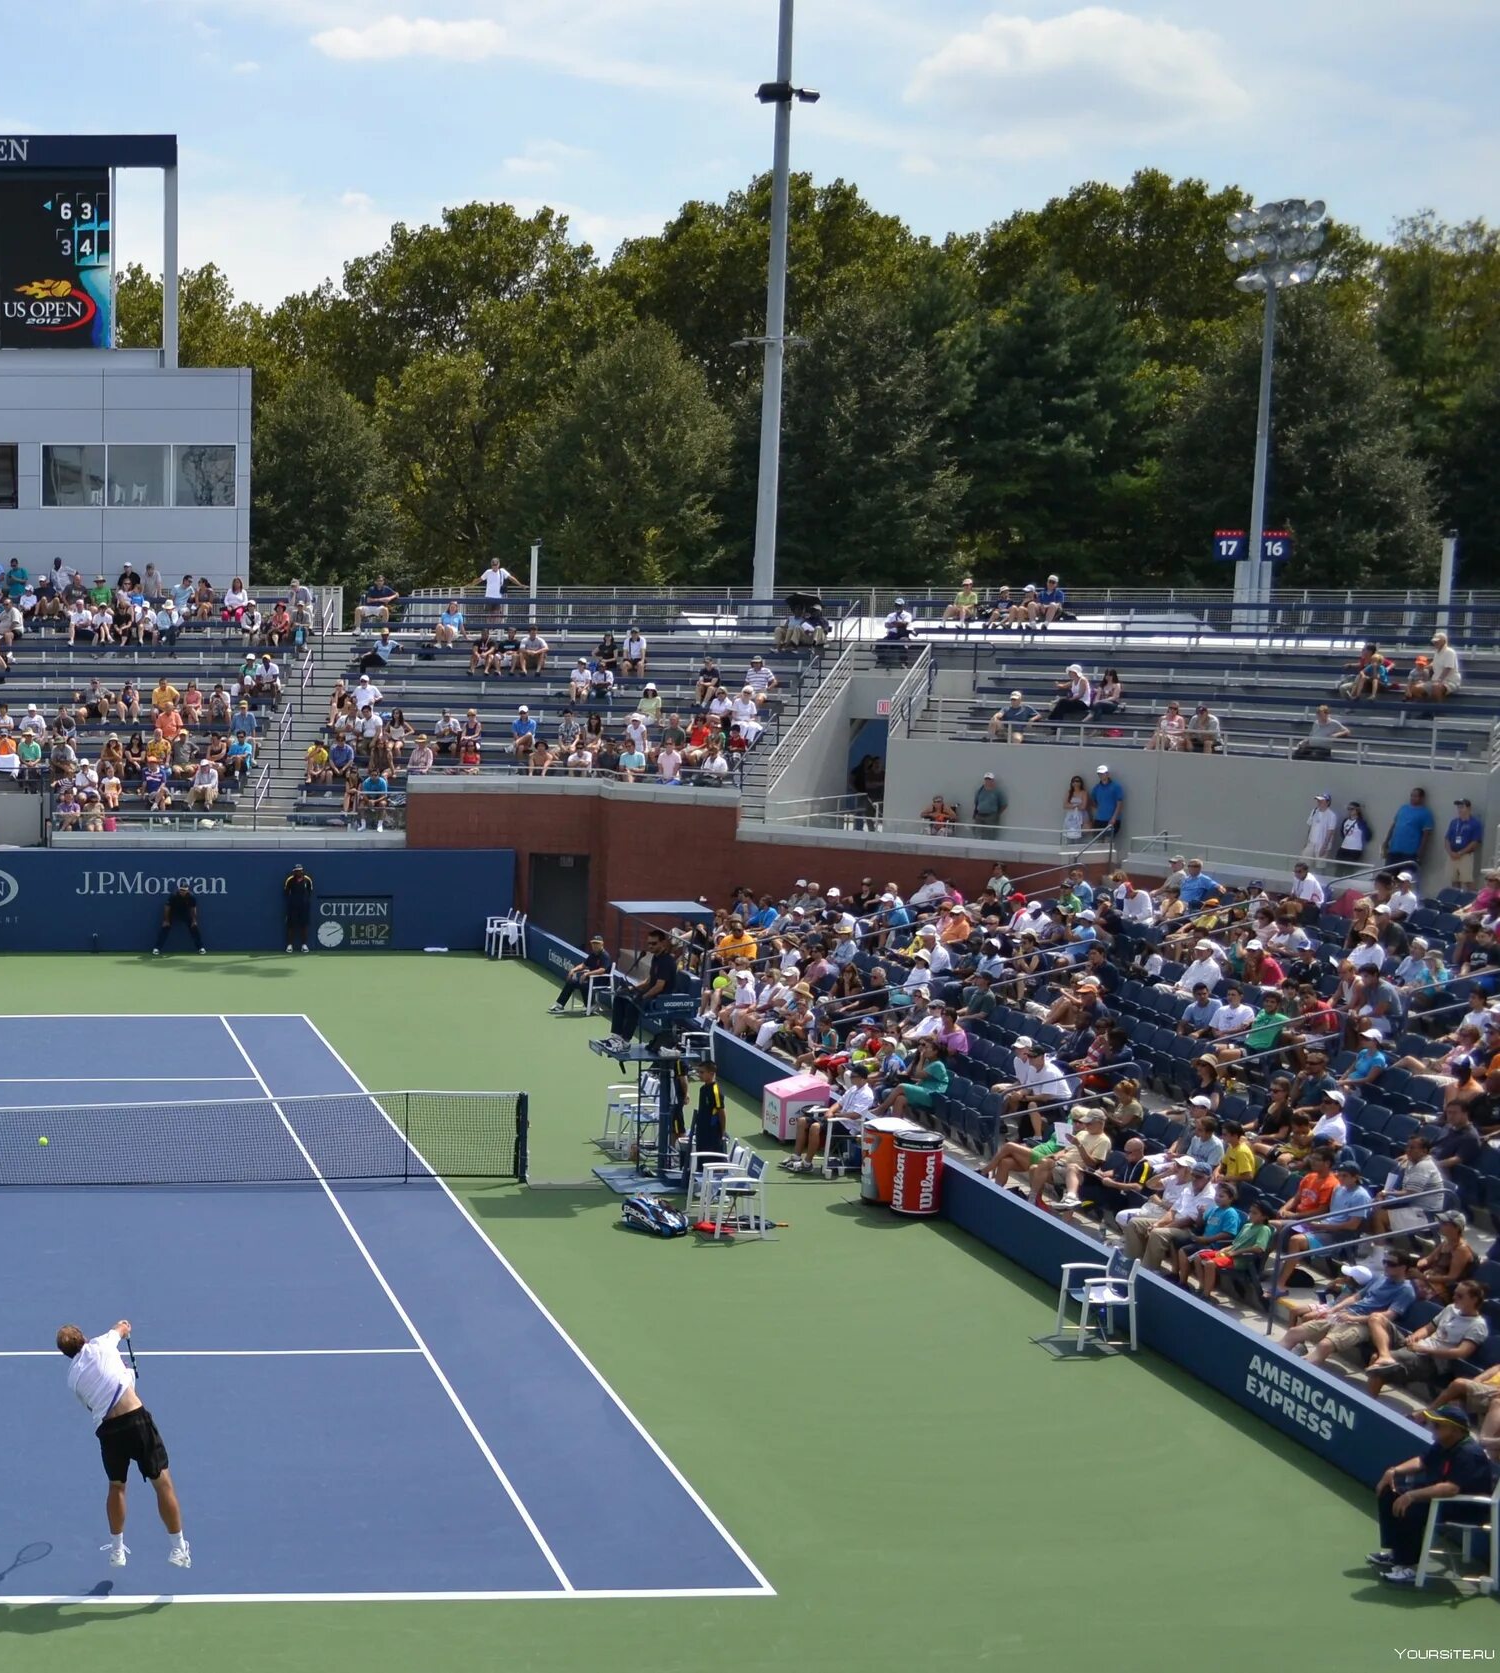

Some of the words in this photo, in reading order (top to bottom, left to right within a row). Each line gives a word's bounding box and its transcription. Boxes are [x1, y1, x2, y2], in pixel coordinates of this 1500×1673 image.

[60, 202, 72, 220] 6
[80, 202, 92, 220] 3
[61, 239, 71, 256] 3
[80, 238, 92, 256] 4
[3, 301, 26, 318] US
[30, 301, 82, 318] OPEN
[1219, 540, 1238, 556] 17
[1265, 541, 1283, 556] 16
[320, 902, 388, 917] CITIZEN
[350, 923, 389, 939] 1:02
[893, 1152, 906, 1208] Wilson
[920, 1155, 936, 1209] Wilson
[1248, 1355, 1355, 1431] AMERICAN
[1245, 1374, 1332, 1441] EXPRESS
